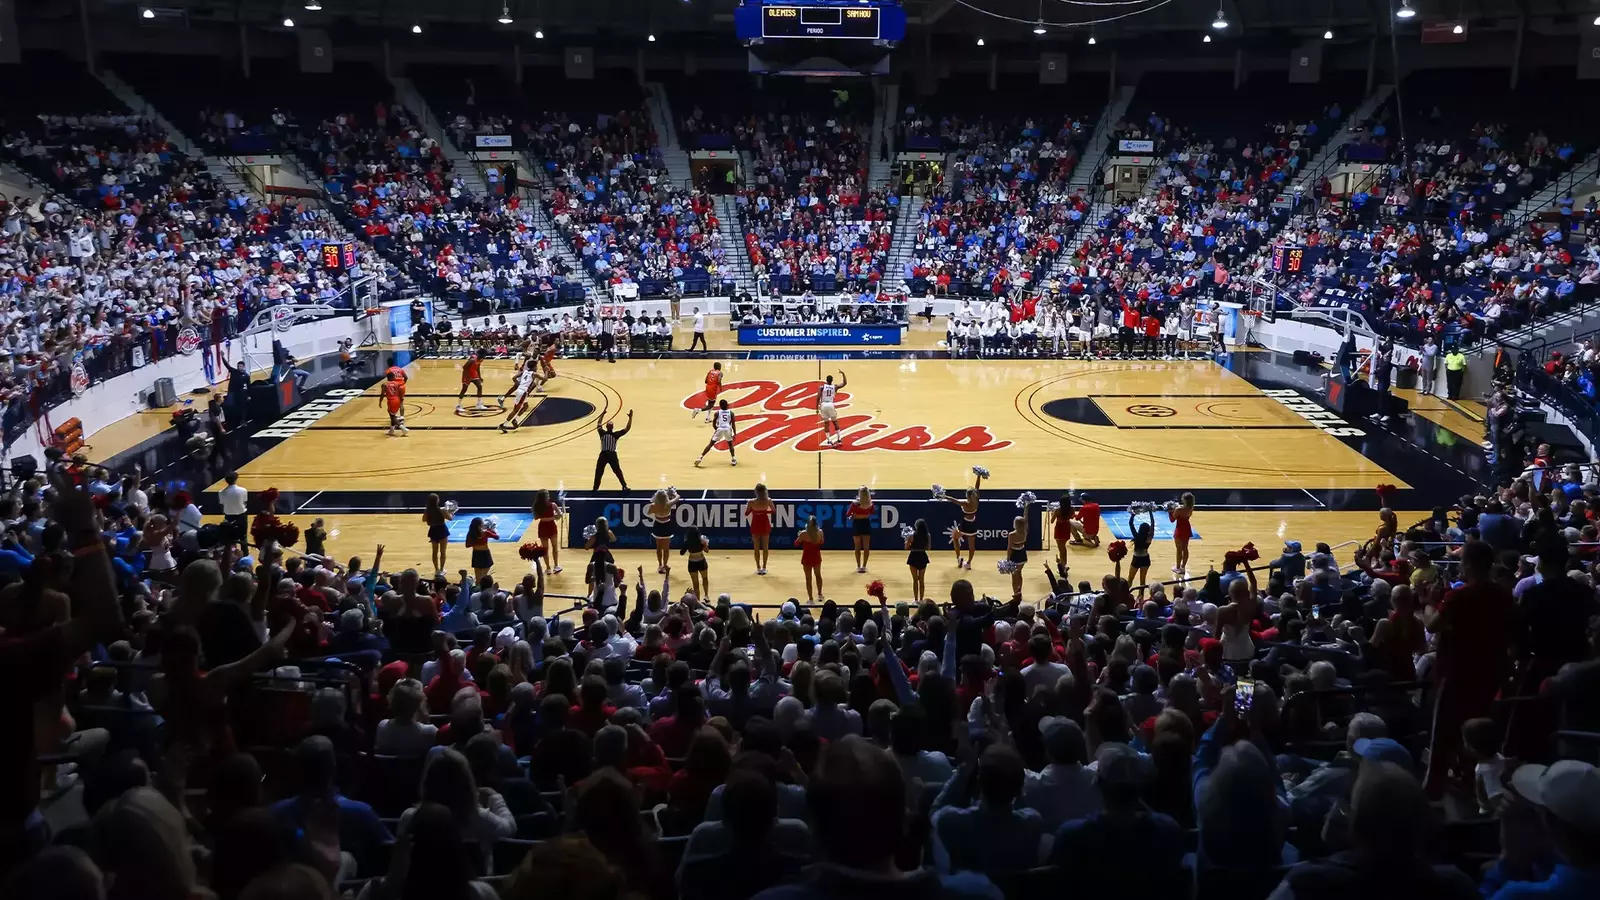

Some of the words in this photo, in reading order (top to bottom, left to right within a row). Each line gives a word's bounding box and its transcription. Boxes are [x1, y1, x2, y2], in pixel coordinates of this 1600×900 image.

[325, 253, 339, 268] 30
[1287, 257, 1301, 271] 30
[757, 328, 805, 337] CUSTOMER
[806, 328, 851, 337] INSPIRED.
[523, 374, 529, 382] 4
[681, 380, 854, 411] Ole
[250, 388, 365, 438] REBELS
[722, 414, 728, 422] 5
[1260, 388, 1367, 437] REBELS
[712, 413, 1015, 453] Miss
